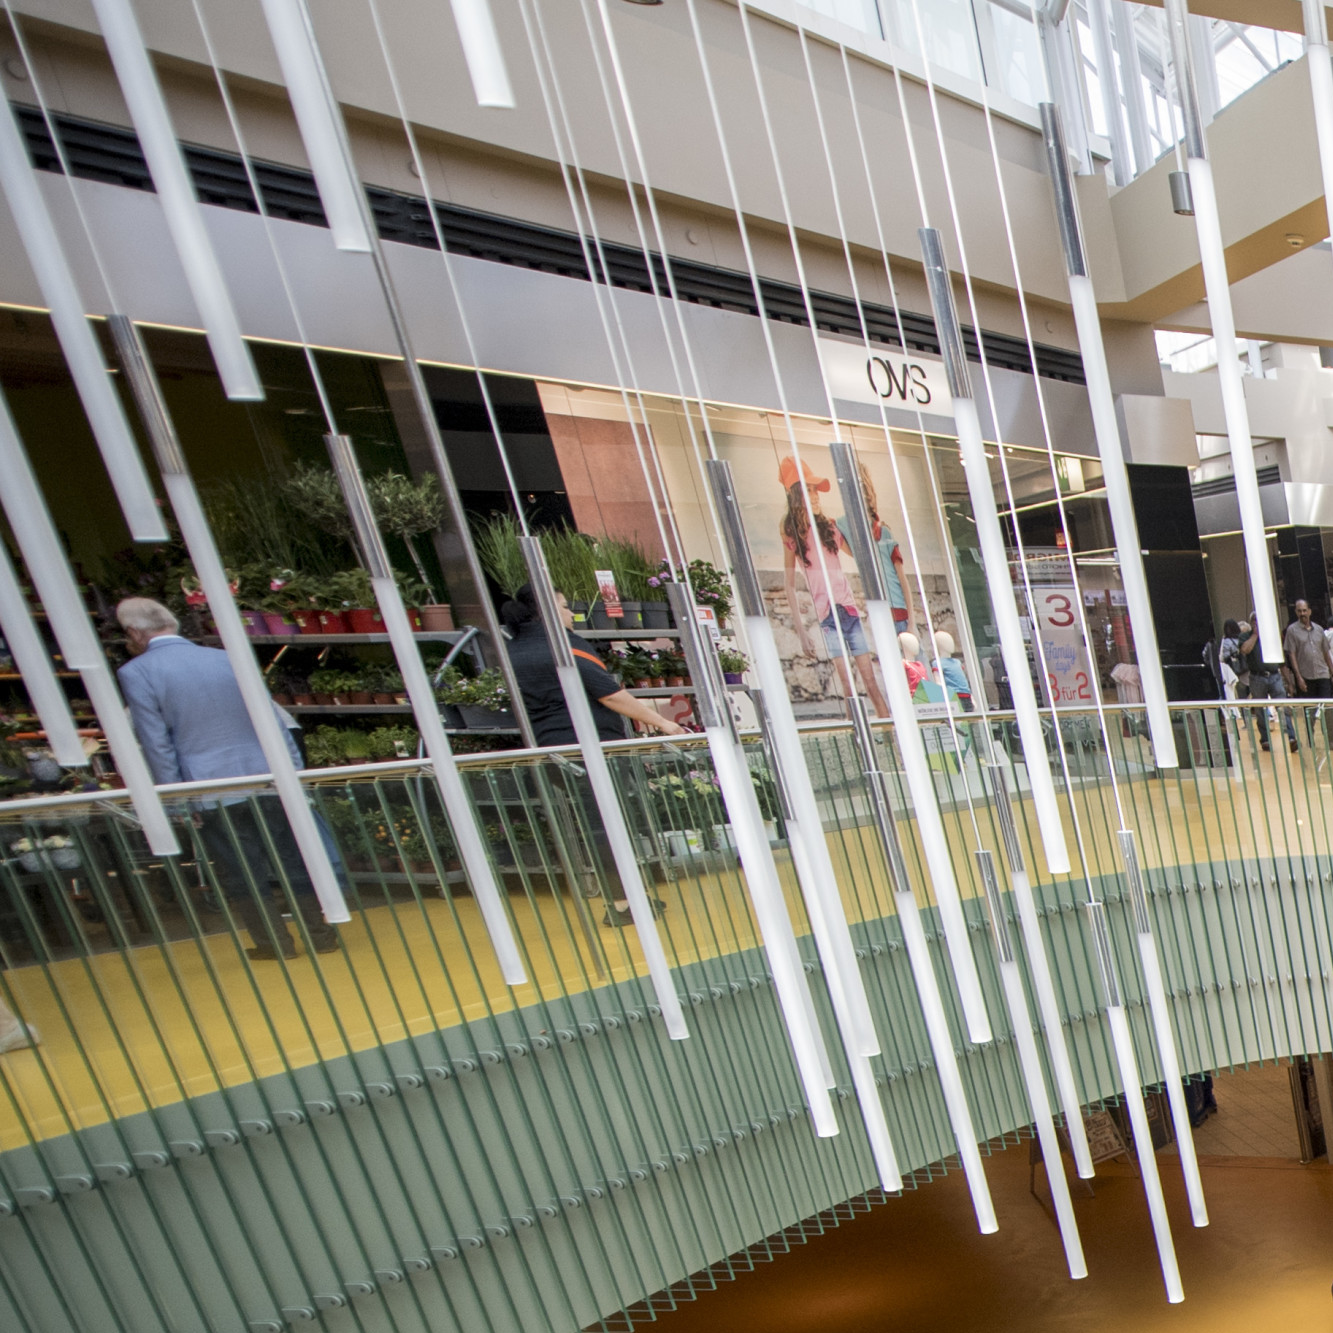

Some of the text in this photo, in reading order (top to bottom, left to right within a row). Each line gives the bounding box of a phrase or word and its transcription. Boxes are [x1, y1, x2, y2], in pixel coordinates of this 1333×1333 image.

[866, 357, 932, 404] OVS
[1045, 594, 1075, 627] 3
[1062, 686, 1077, 700] für
[1075, 672, 1091, 699] 2
